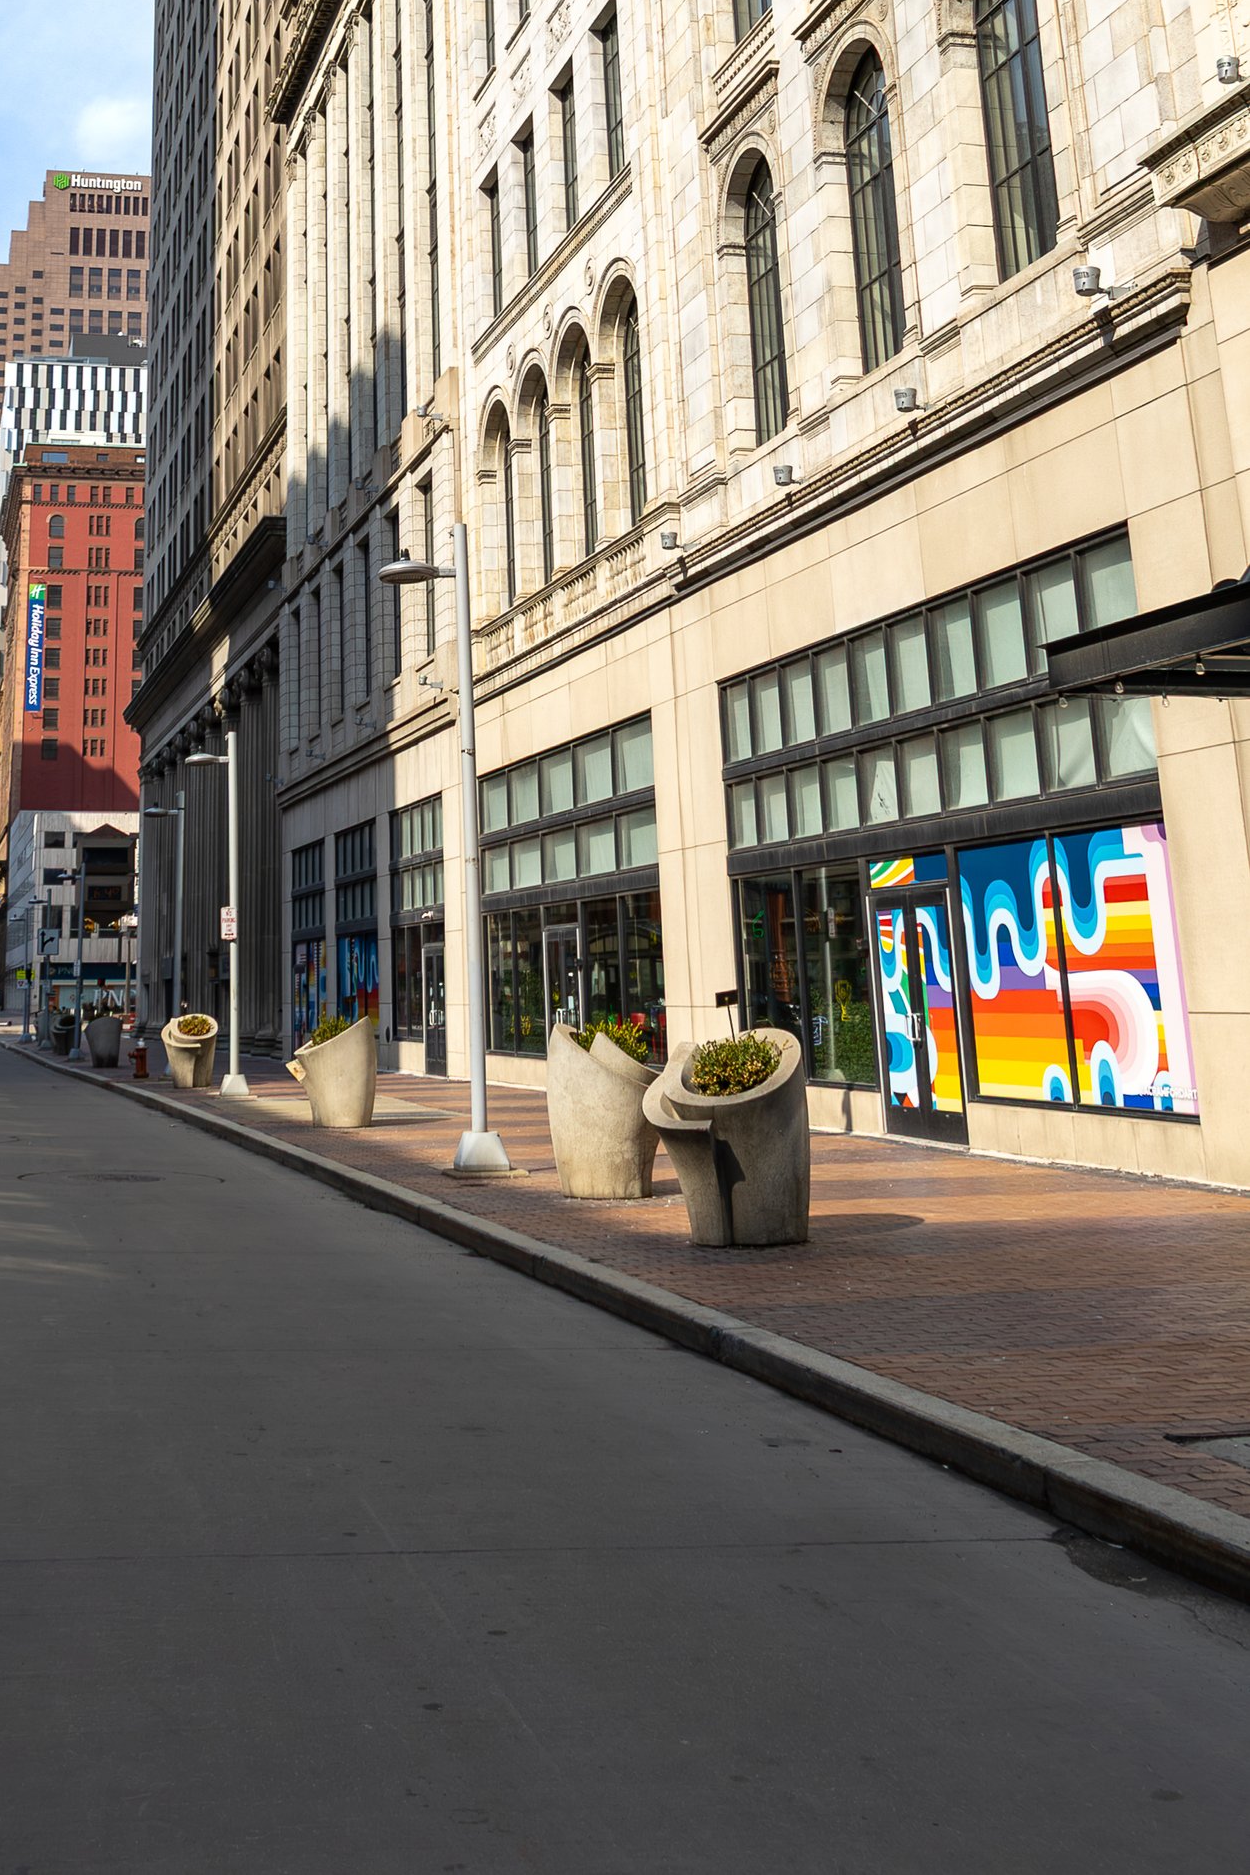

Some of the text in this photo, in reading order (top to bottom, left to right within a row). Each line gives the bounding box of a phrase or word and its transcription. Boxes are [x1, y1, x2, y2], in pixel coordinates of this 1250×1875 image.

[71, 173, 142, 193] Huntington
[27, 603, 44, 705] Holiday Inn Express
